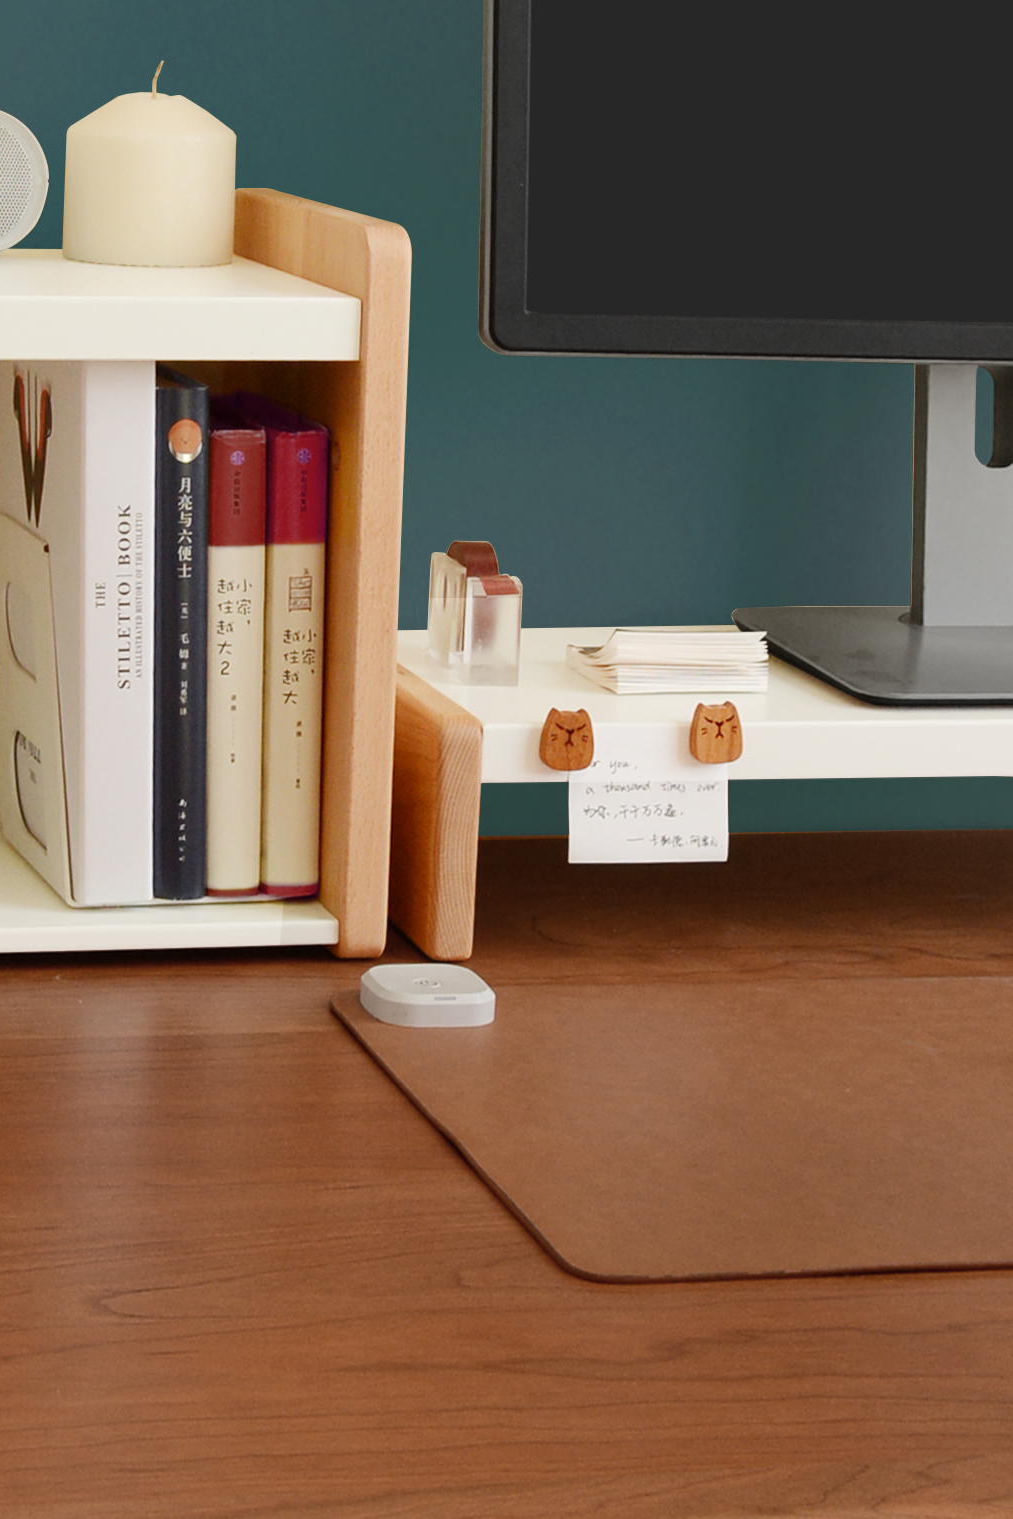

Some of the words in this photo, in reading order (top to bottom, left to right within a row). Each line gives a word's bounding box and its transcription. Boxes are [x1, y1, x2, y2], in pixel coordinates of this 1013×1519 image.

[117, 504, 132, 566] BOOK
[135, 512, 143, 550] STILETTO
[177, 477, 193, 579] 月亮与六便士
[135, 552, 143, 566] THE
[135, 568, 143, 578] OF
[95, 581, 107, 609] THE
[135, 581, 143, 614] HISTORY
[117, 581, 132, 690] STILETTO
[135, 615, 143, 667] ILLUSTRATED
[135, 668, 143, 679] AN
[282, 628, 301, 705] 越住越大
[585, 786, 595, 795] a
[603, 781, 651, 794] thousand
[660, 781, 687, 794] times
